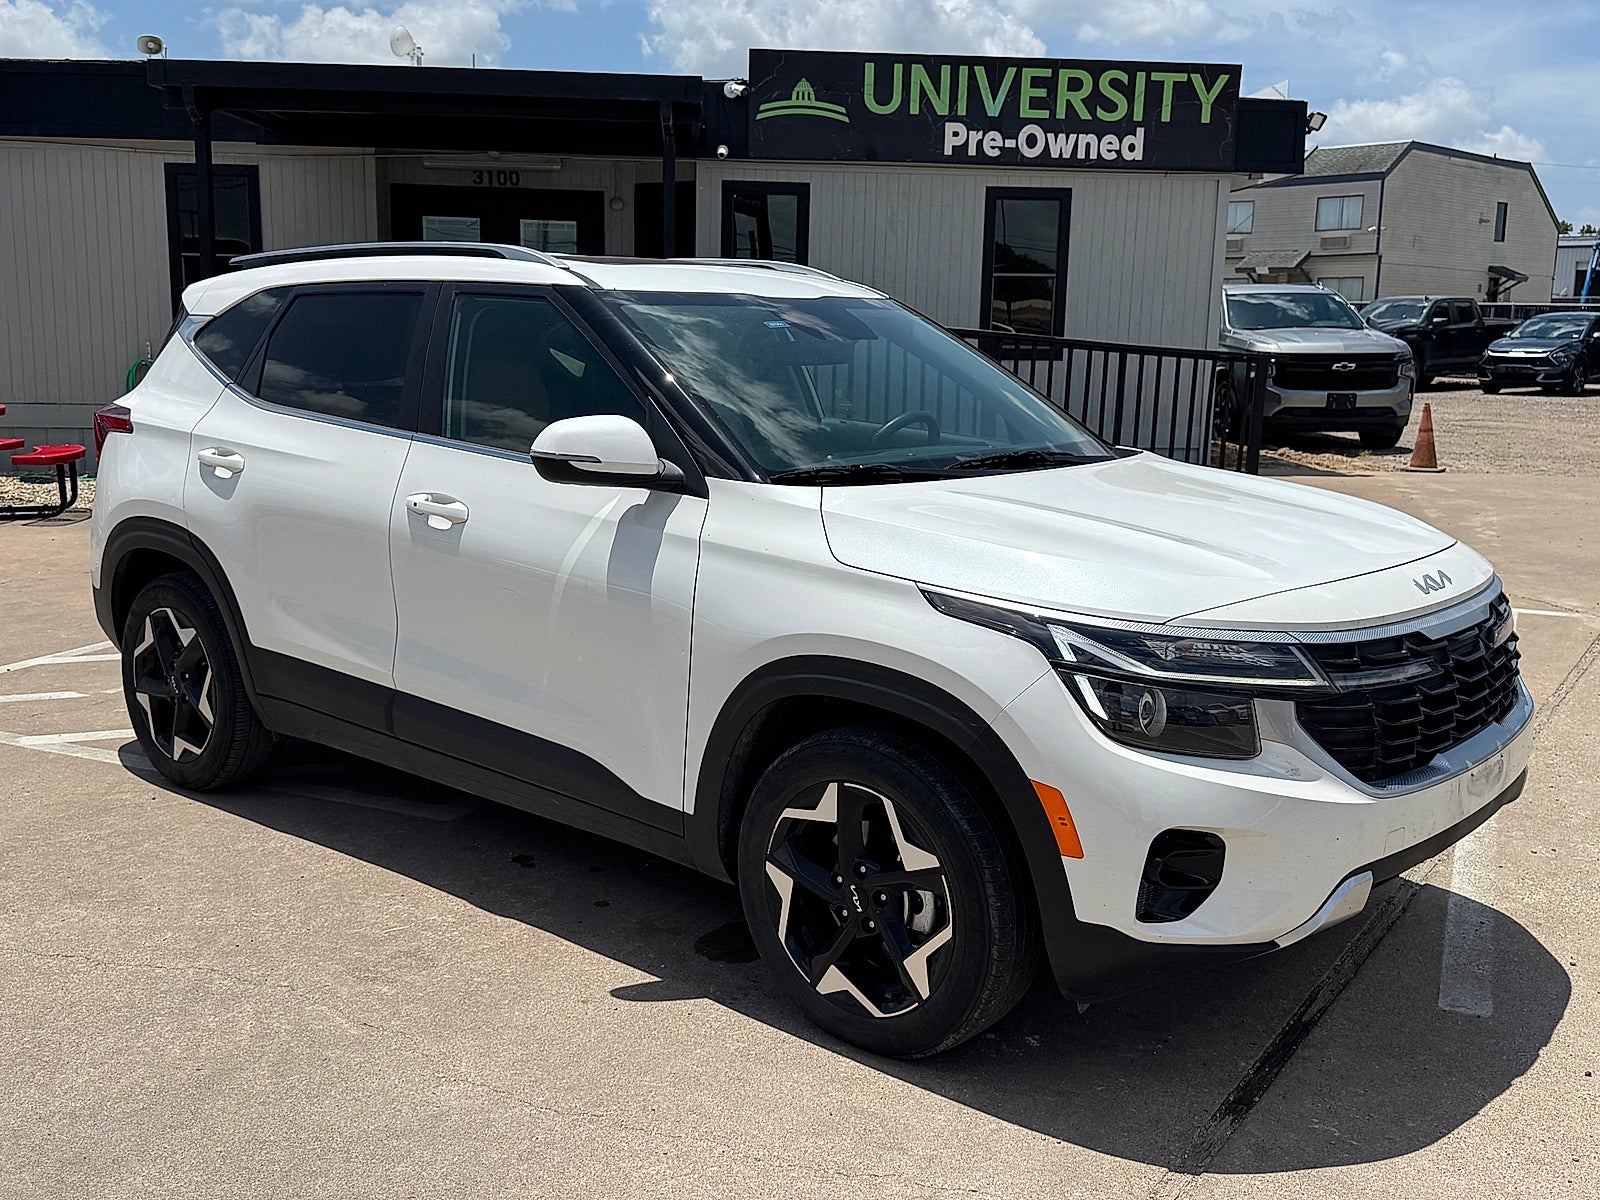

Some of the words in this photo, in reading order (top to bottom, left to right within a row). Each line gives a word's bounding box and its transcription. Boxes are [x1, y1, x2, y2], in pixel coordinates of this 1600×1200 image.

[864, 62, 1231, 124] UNIVERSITY
[944, 121, 1146, 161] Pre-Owned
[472, 170, 520, 187] 3100
